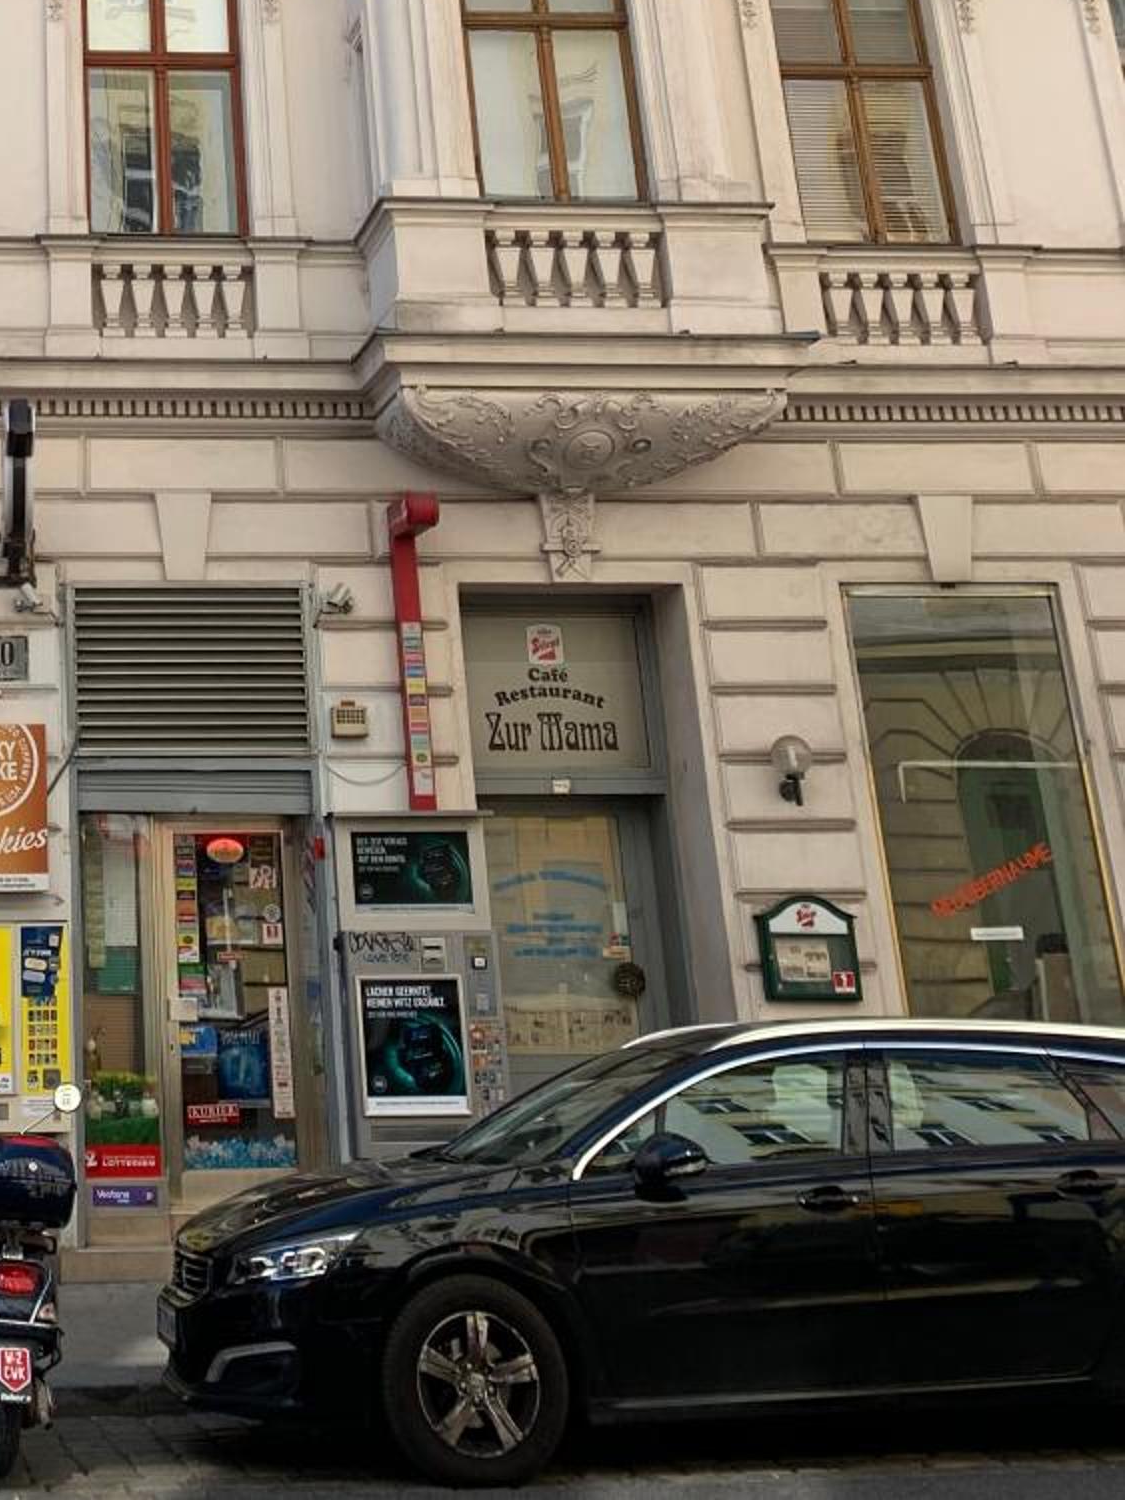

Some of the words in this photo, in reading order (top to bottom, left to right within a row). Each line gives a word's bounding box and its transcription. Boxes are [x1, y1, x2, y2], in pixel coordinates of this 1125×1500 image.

[527, 667, 569, 683] Café
[494, 685, 605, 709] Restaurant
[485, 712, 532, 752] Zur
[536, 711, 620, 752] Mama
